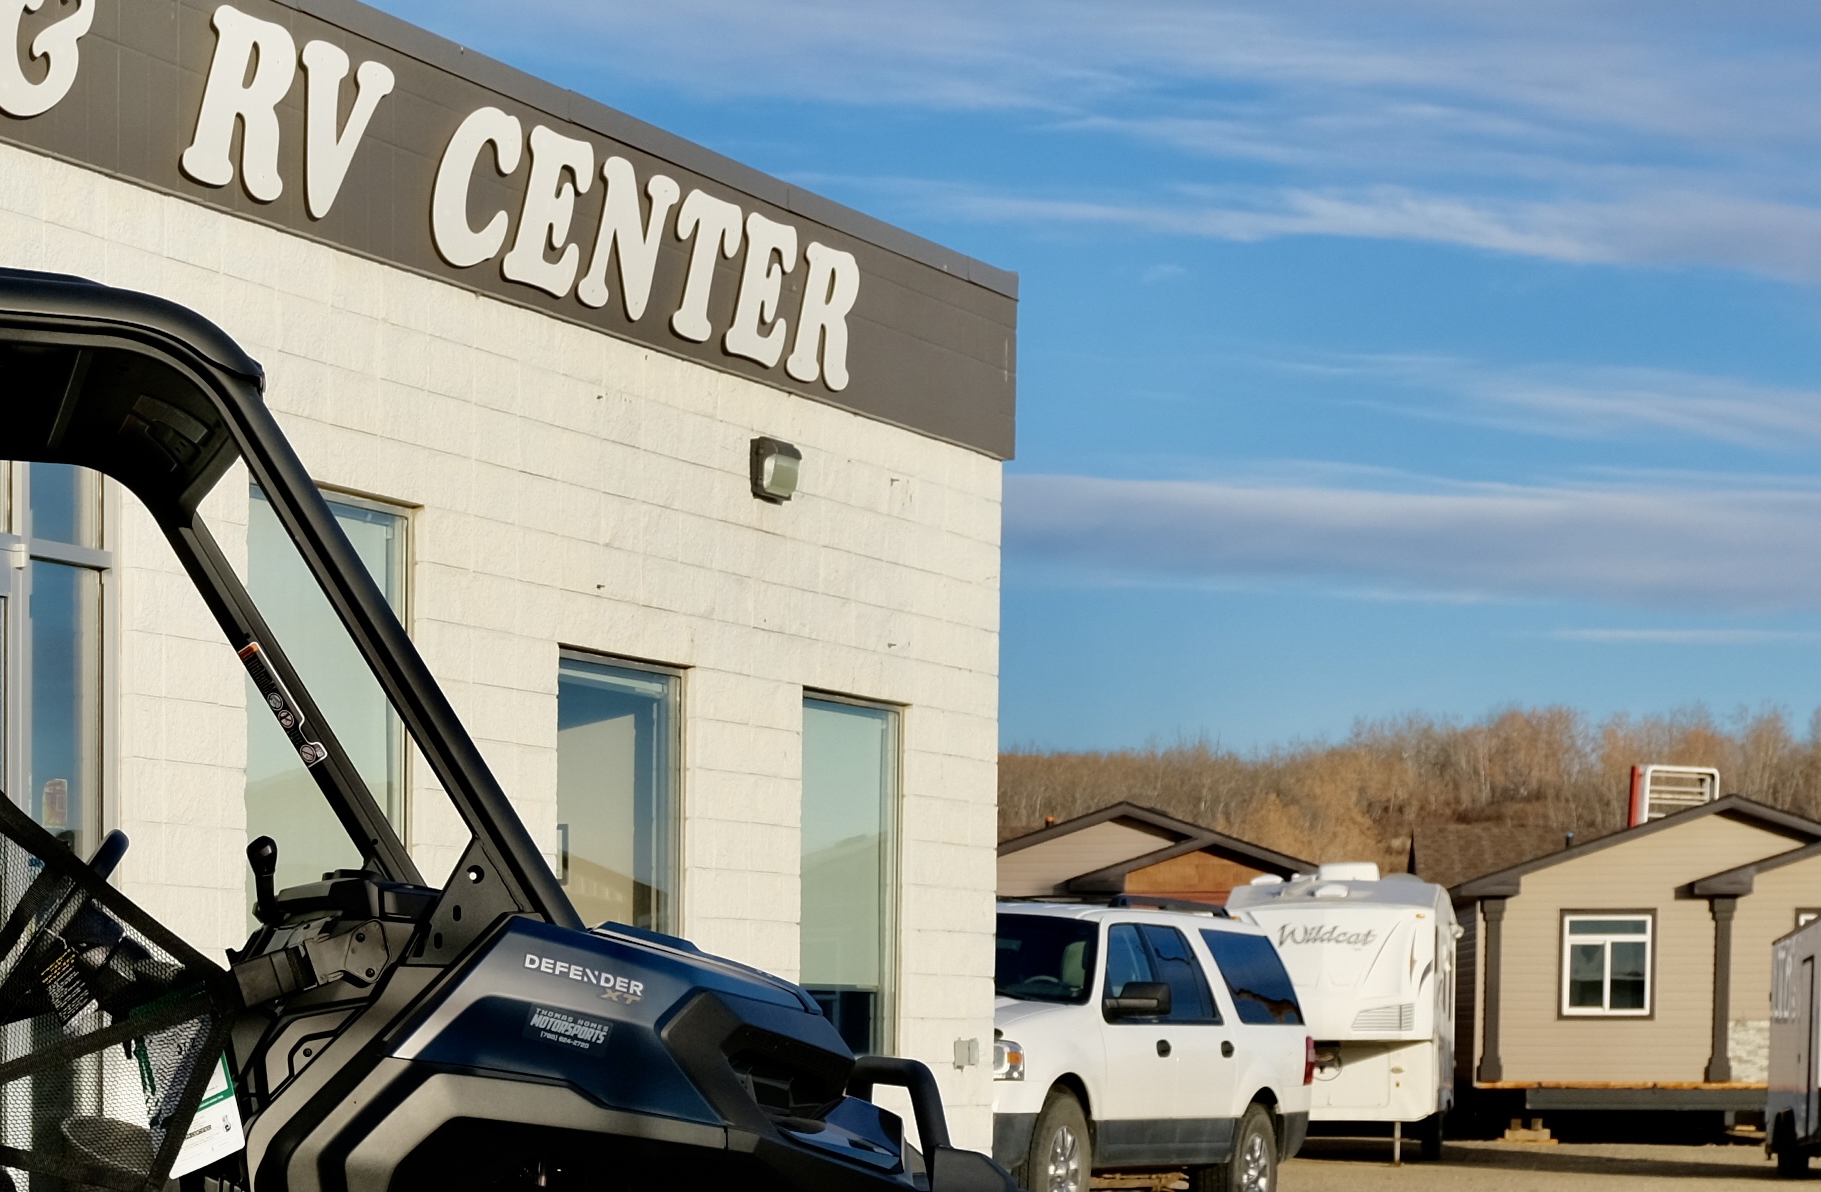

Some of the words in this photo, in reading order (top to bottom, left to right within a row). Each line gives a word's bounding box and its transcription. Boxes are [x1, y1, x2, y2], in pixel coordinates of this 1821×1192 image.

[181, 3, 395, 219] RV
[431, 105, 861, 392] CENTER
[1278, 922, 1378, 948] Wildcat
[524, 953, 644, 996] DEFENDER
[600, 988, 642, 1005] XT
[529, 1013, 608, 1044] MOTORSPORTS
[536, 1007, 574, 1023] THOMAS
[577, 1019, 610, 1032] HOMES
